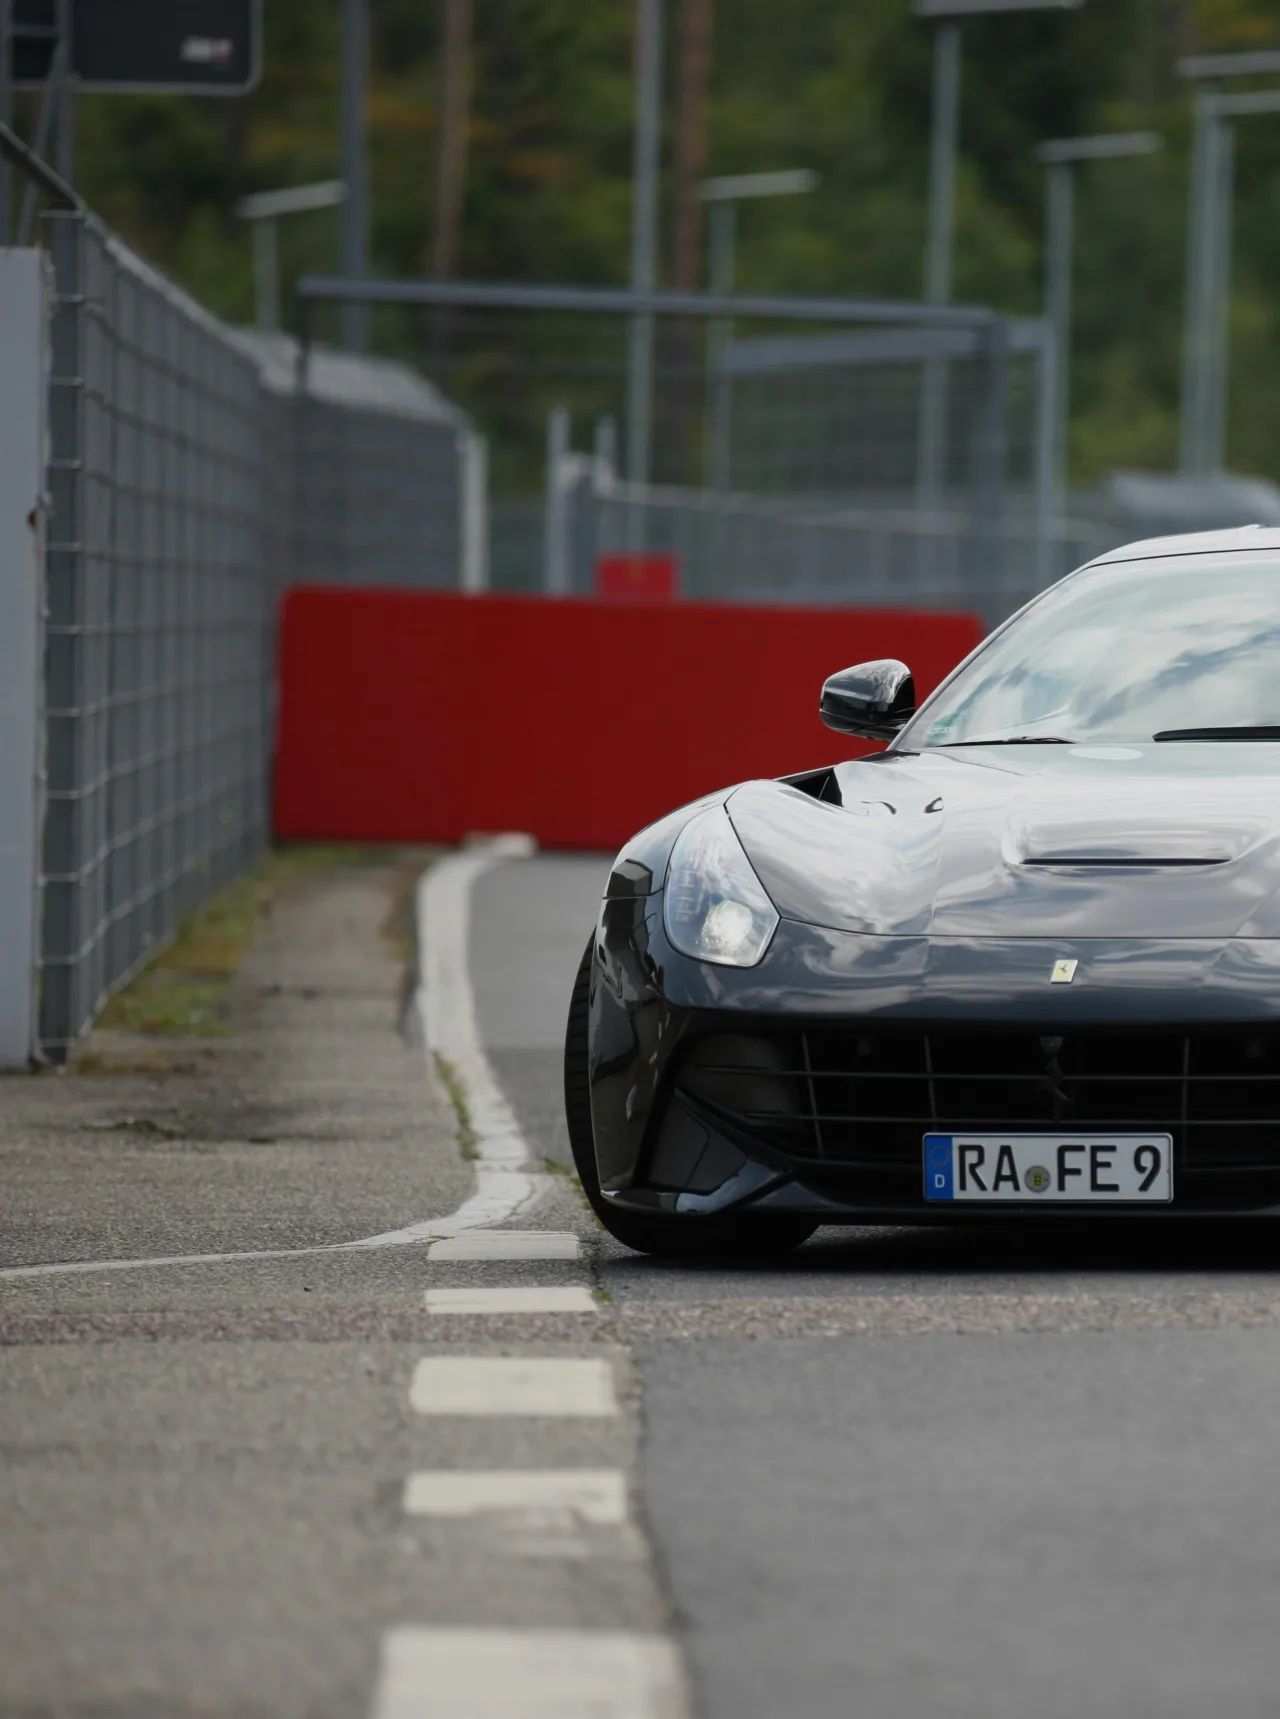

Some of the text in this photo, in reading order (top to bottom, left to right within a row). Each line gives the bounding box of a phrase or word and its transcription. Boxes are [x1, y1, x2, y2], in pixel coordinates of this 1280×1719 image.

[934, 1174, 946, 1188] D
[957, 1144, 1162, 1192] RA FE 9
